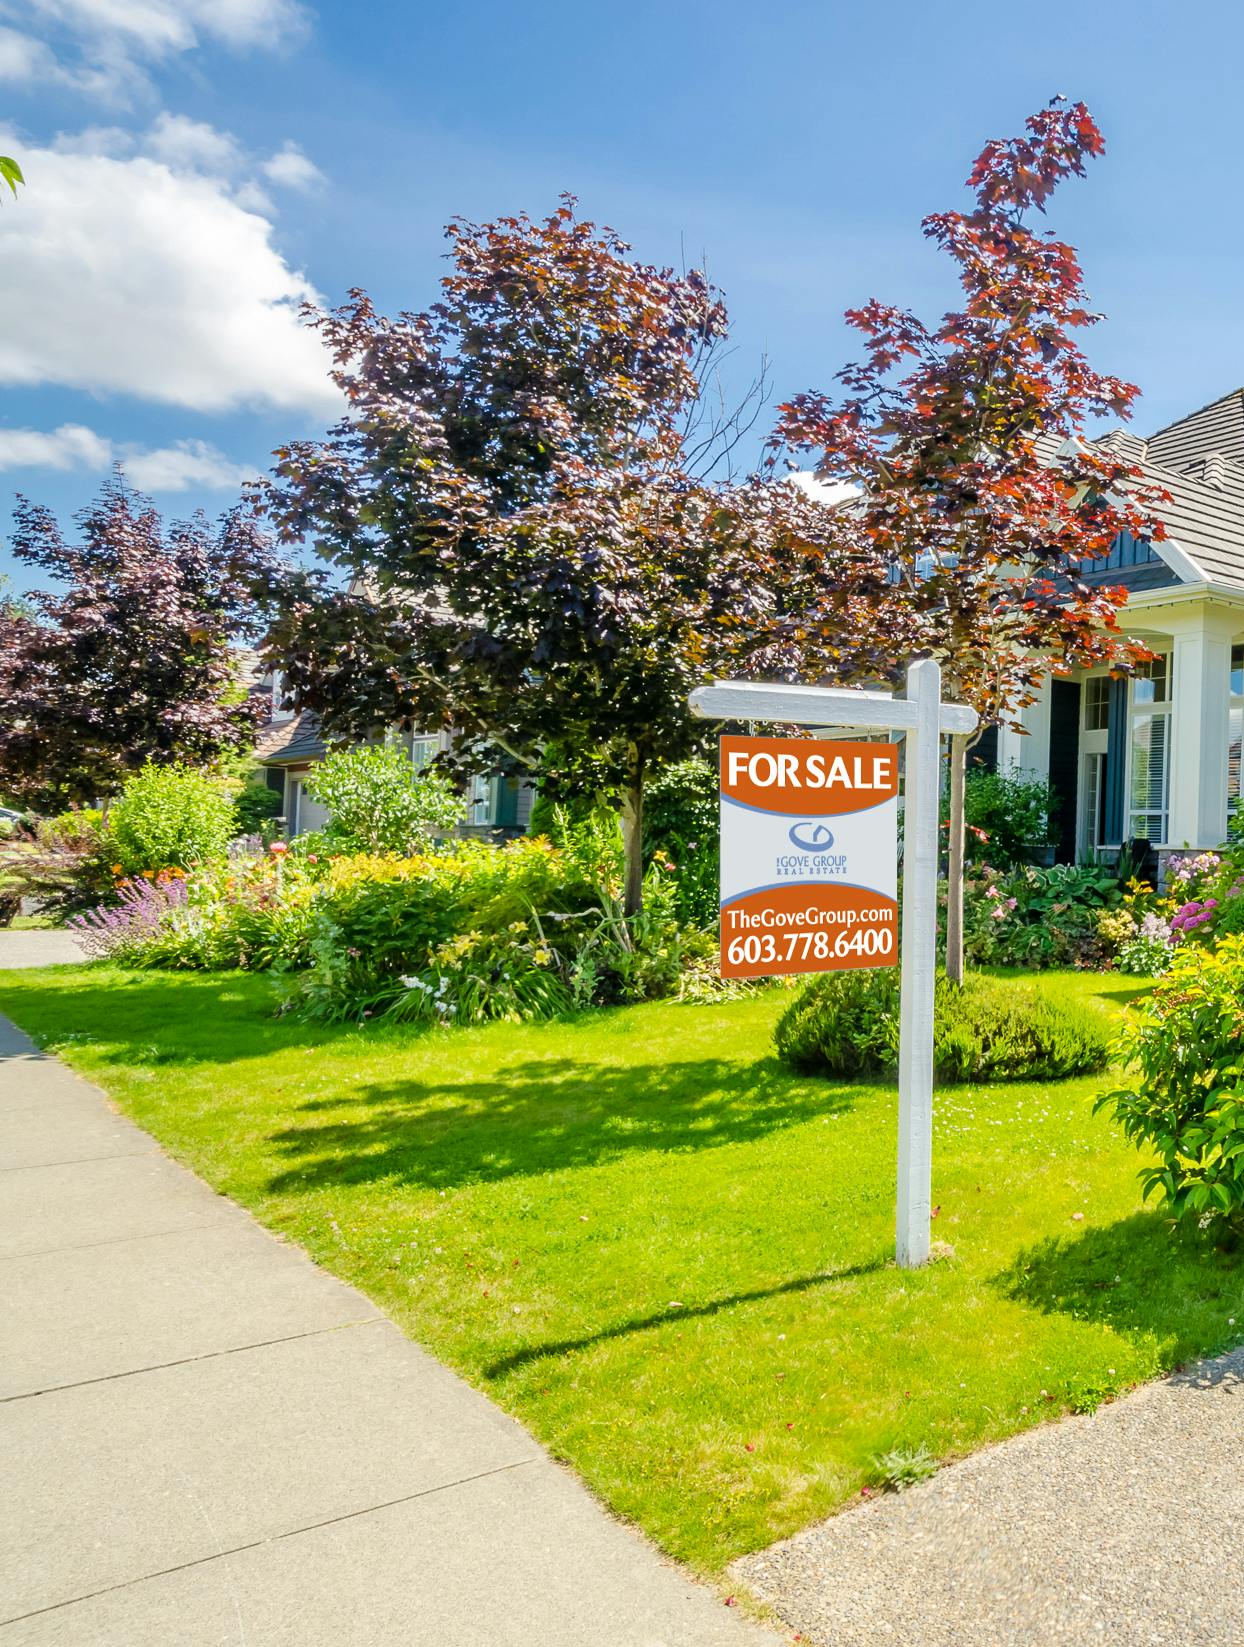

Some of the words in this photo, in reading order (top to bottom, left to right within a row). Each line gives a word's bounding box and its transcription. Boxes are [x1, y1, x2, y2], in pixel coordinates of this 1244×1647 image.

[728, 751, 802, 788] FOR
[805, 754, 892, 790] SALE
[776, 867, 804, 876] REAL
[809, 866, 847, 875] ESTATE
[780, 855, 810, 868] GOVE
[813, 855, 847, 867] GROUP
[727, 907, 893, 929] TheGoveGroup.com
[727, 928, 893, 965] 603.778.6400
